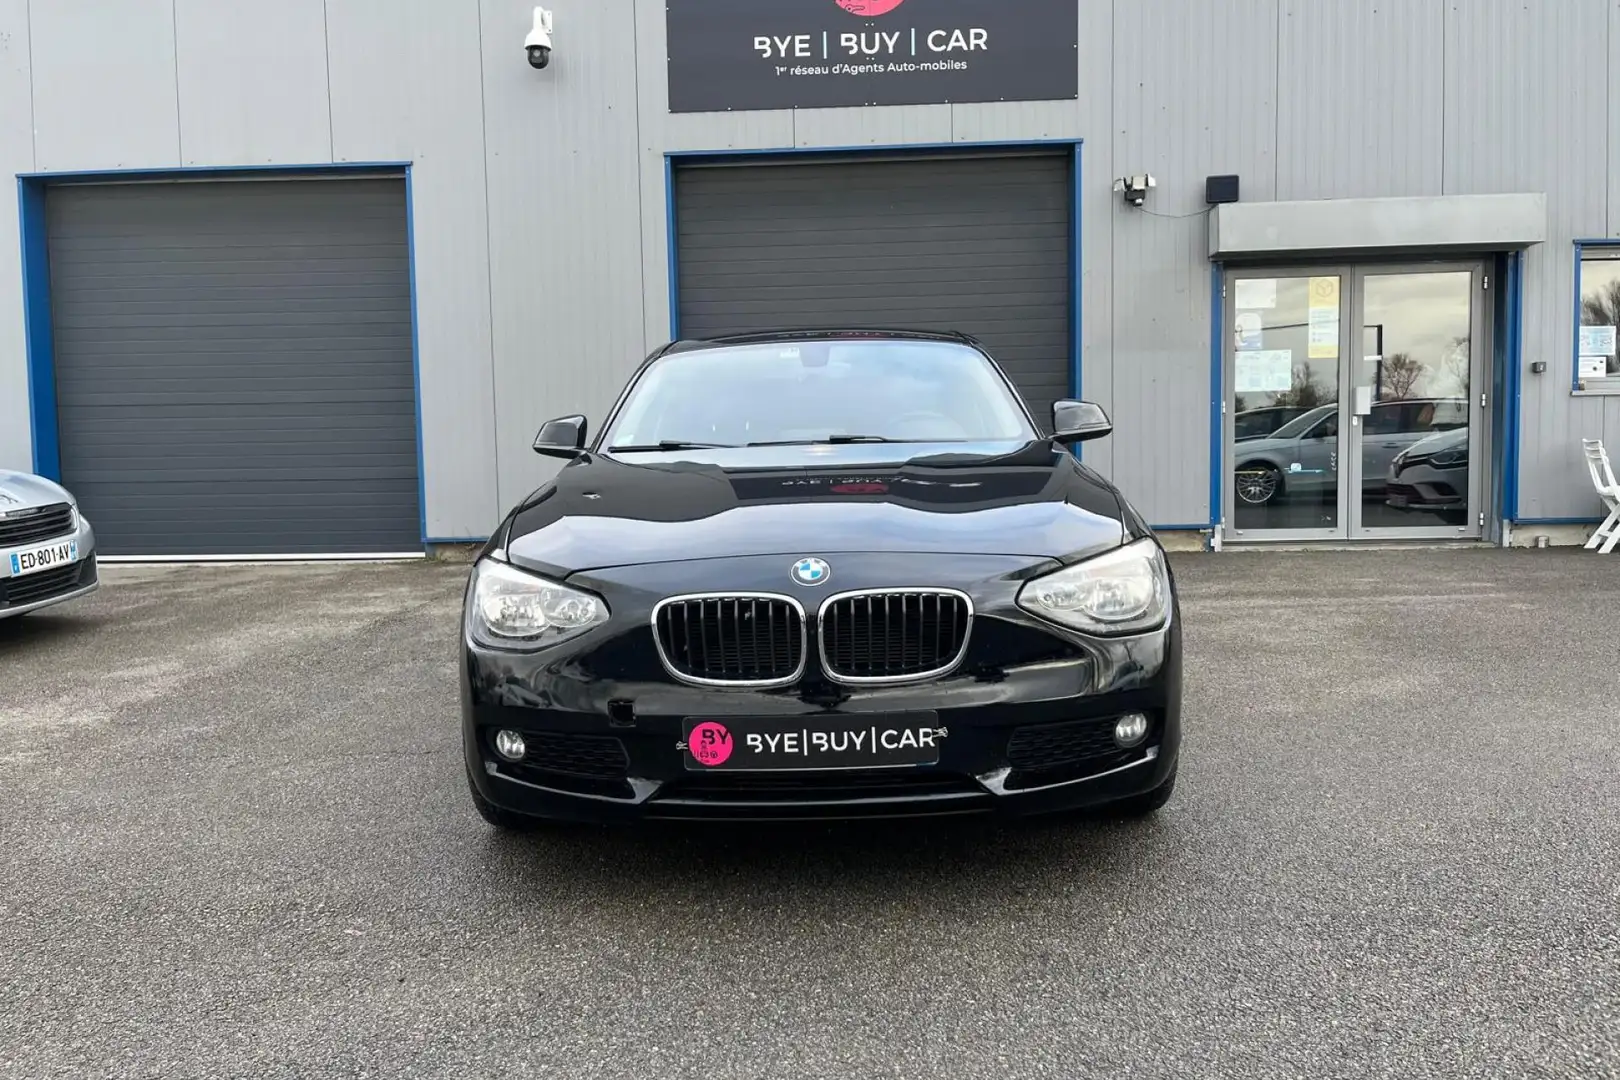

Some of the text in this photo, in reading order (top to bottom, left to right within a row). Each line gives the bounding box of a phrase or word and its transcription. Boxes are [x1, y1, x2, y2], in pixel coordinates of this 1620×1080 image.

[753, 35, 811, 58] BYE
[927, 28, 988, 51] CAR
[790, 65, 829, 76] réseau
[887, 60, 967, 72] Auto-mobiles
